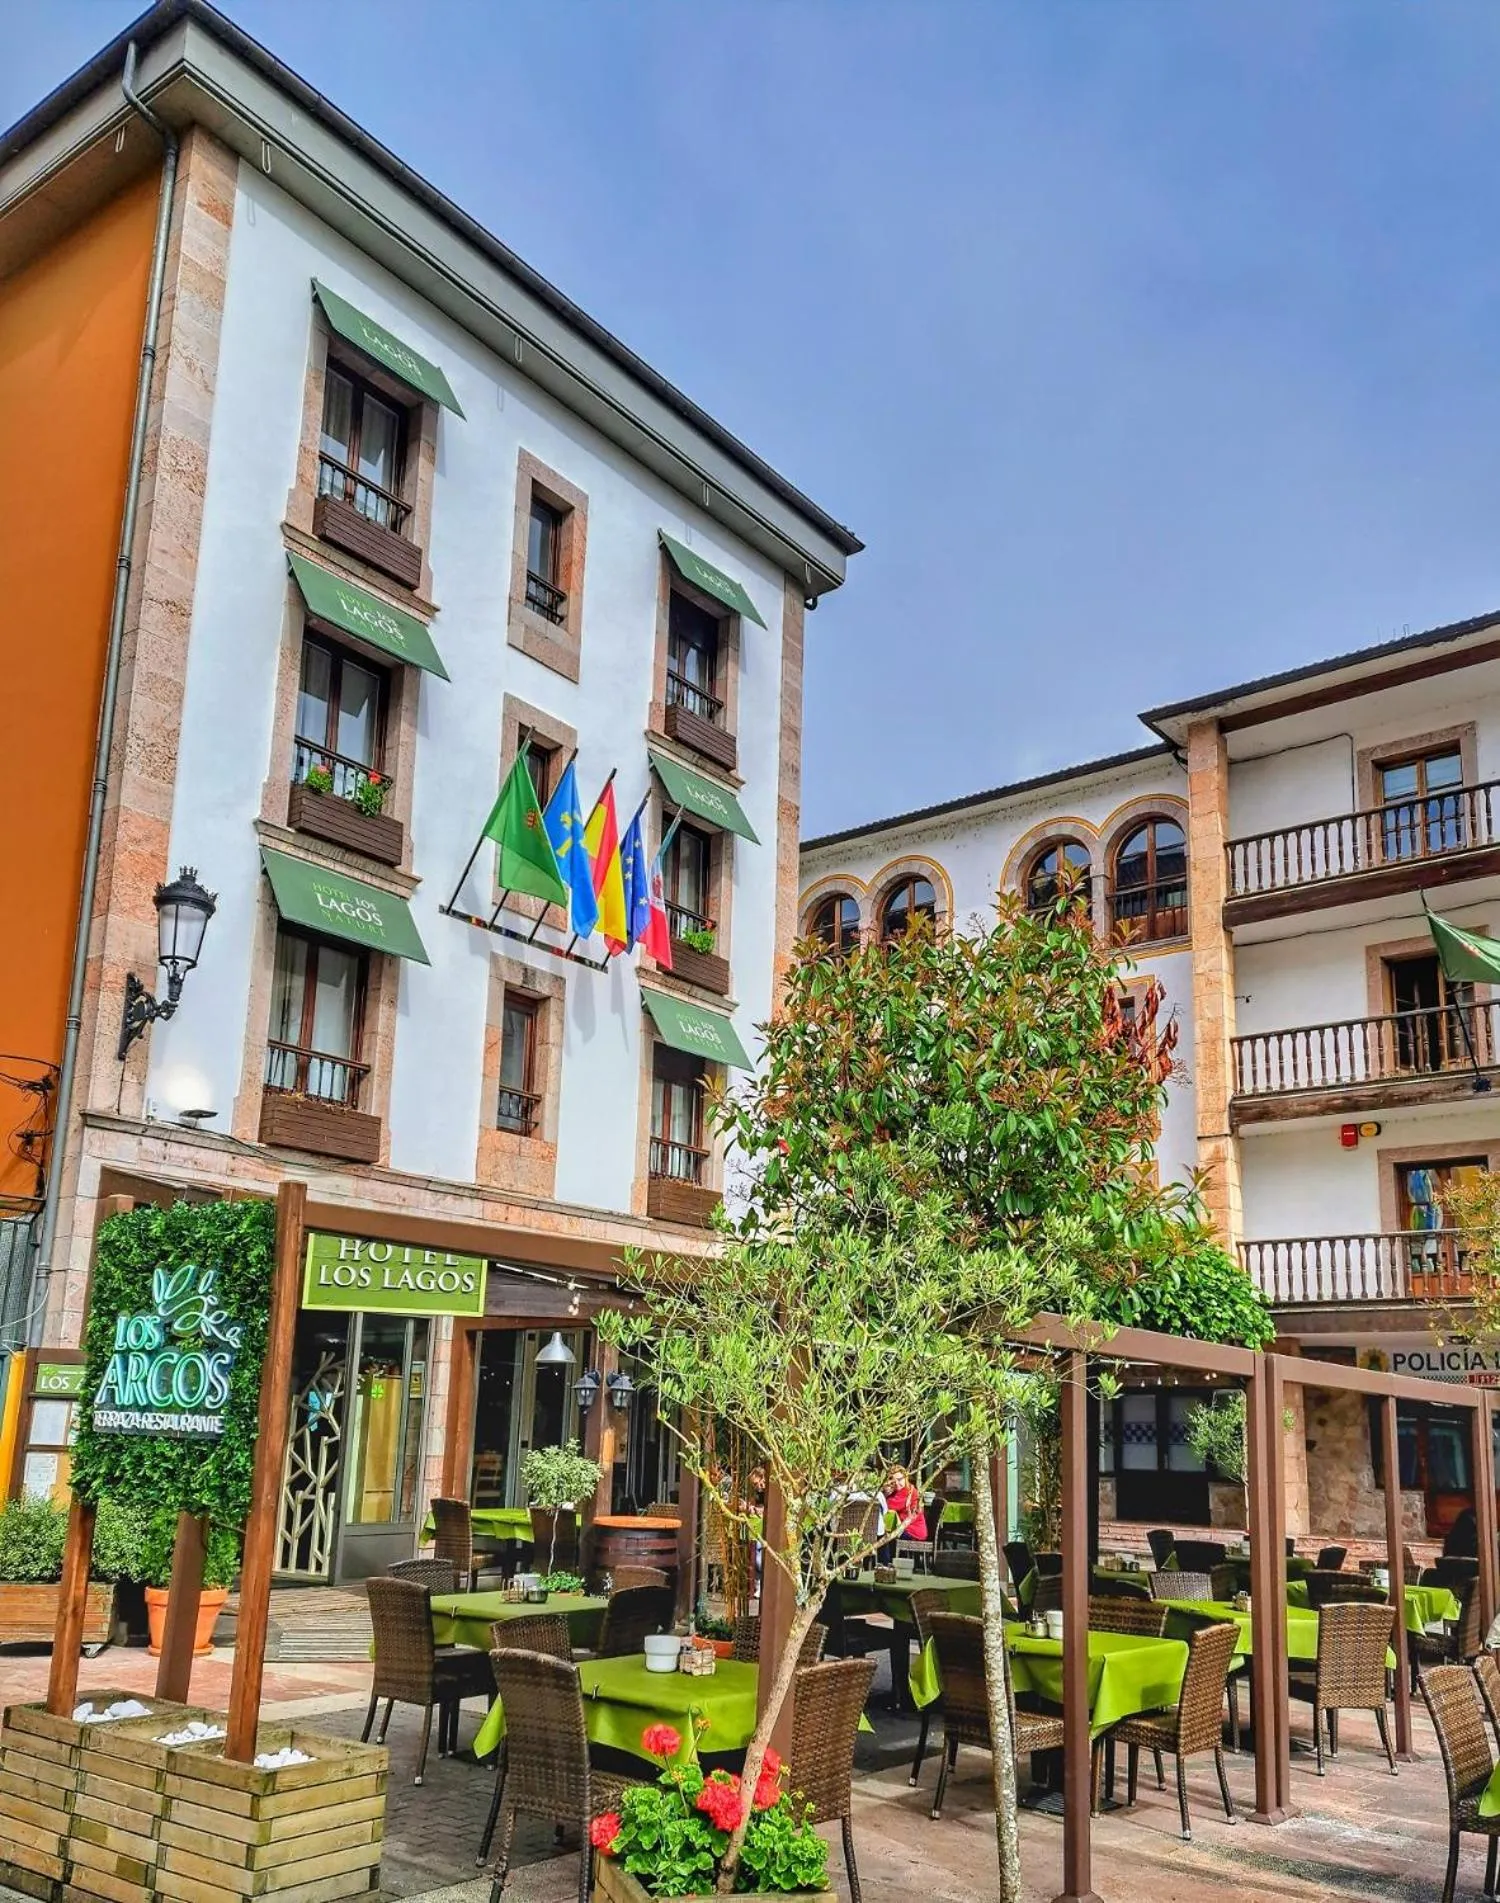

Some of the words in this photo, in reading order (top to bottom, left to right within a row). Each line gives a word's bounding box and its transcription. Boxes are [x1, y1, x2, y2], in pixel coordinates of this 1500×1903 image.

[340, 598, 405, 640] LAGOS
[314, 892, 383, 926] LAGOS
[318, 1264, 372, 1288] LOS
[382, 1268, 475, 1293] LAGOS
[114, 1315, 161, 1351] LOS
[1392, 1347, 1487, 1372] POLICÍA
[41, 1375, 70, 1390] LOS
[94, 1351, 231, 1409] ARCOS
